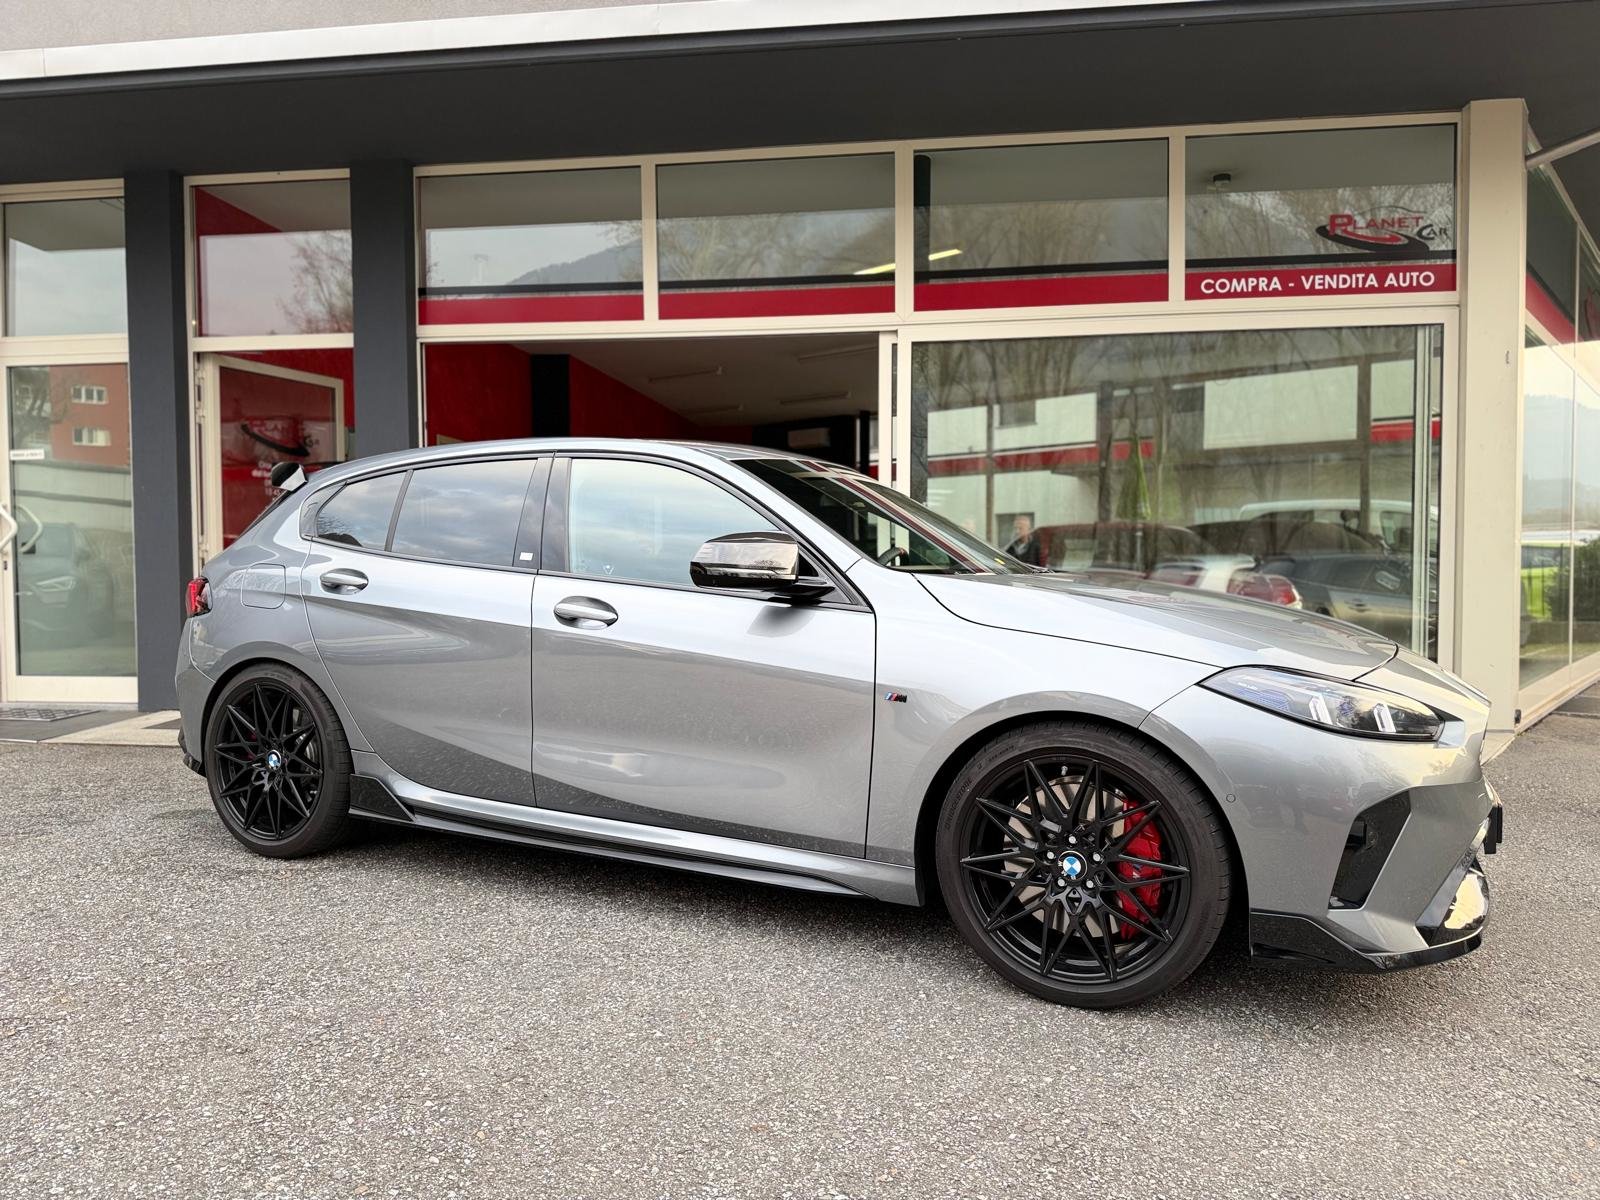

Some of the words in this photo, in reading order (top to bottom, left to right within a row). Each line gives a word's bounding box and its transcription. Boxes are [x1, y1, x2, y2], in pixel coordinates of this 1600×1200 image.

[1200, 276, 1282, 294] COMPRA
[1301, 273, 1378, 290] VENDITA
[1384, 271, 1435, 287] AUTO
